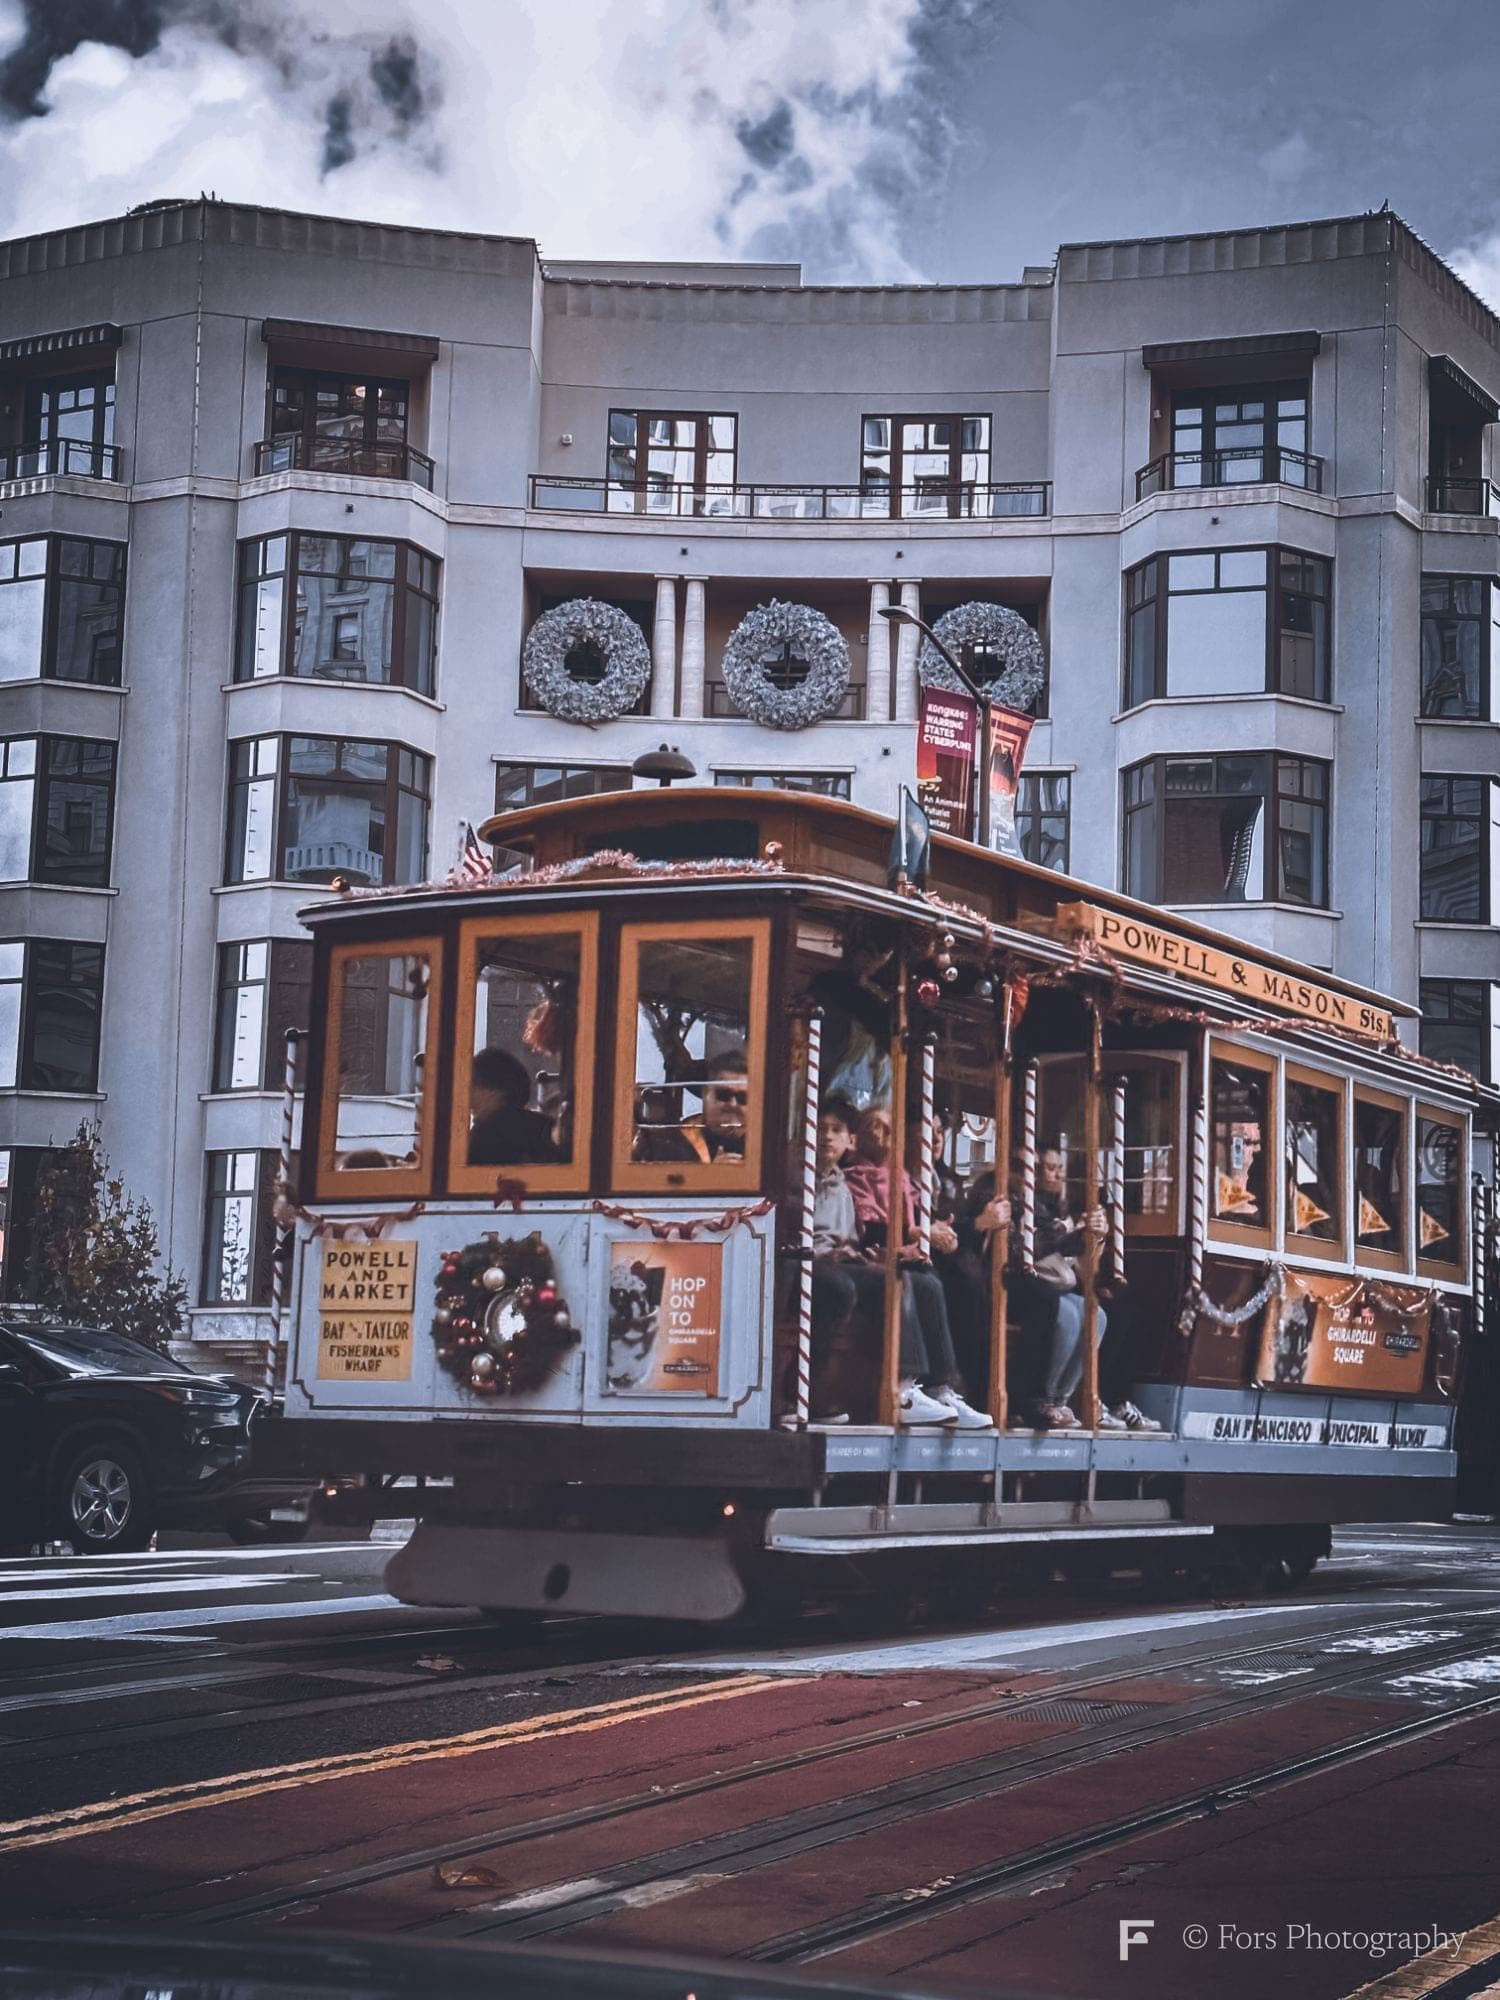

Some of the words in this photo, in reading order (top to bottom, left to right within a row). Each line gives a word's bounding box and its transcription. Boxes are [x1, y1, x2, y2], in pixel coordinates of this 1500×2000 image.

[926, 714, 964, 730] WARRING
[924, 724, 955, 738] STATES
[923, 734, 972, 752] CYBERPUNK
[1101, 915, 1217, 976] POWELL
[1231, 962, 1248, 987] &
[1263, 974, 1346, 1021] MASON
[1359, 1009, 1388, 1035] Sts.
[326, 1251, 409, 1268] POWELL
[347, 1269, 388, 1282] AND
[322, 1283, 409, 1300] MARKET
[670, 1277, 707, 1291] HOP
[669, 1294, 695, 1309] ON
[669, 1311, 692, 1326] TO
[1333, 1306, 1351, 1322] HOP
[323, 1320, 345, 1340] BAY
[365, 1320, 409, 1340] TAYLOR
[1327, 1326, 1377, 1345] GHIRARDELLI
[1333, 1346, 1365, 1364] SQUARE
[345, 1359, 382, 1372] WHARF
[1213, 1417, 1241, 1439] SAN
